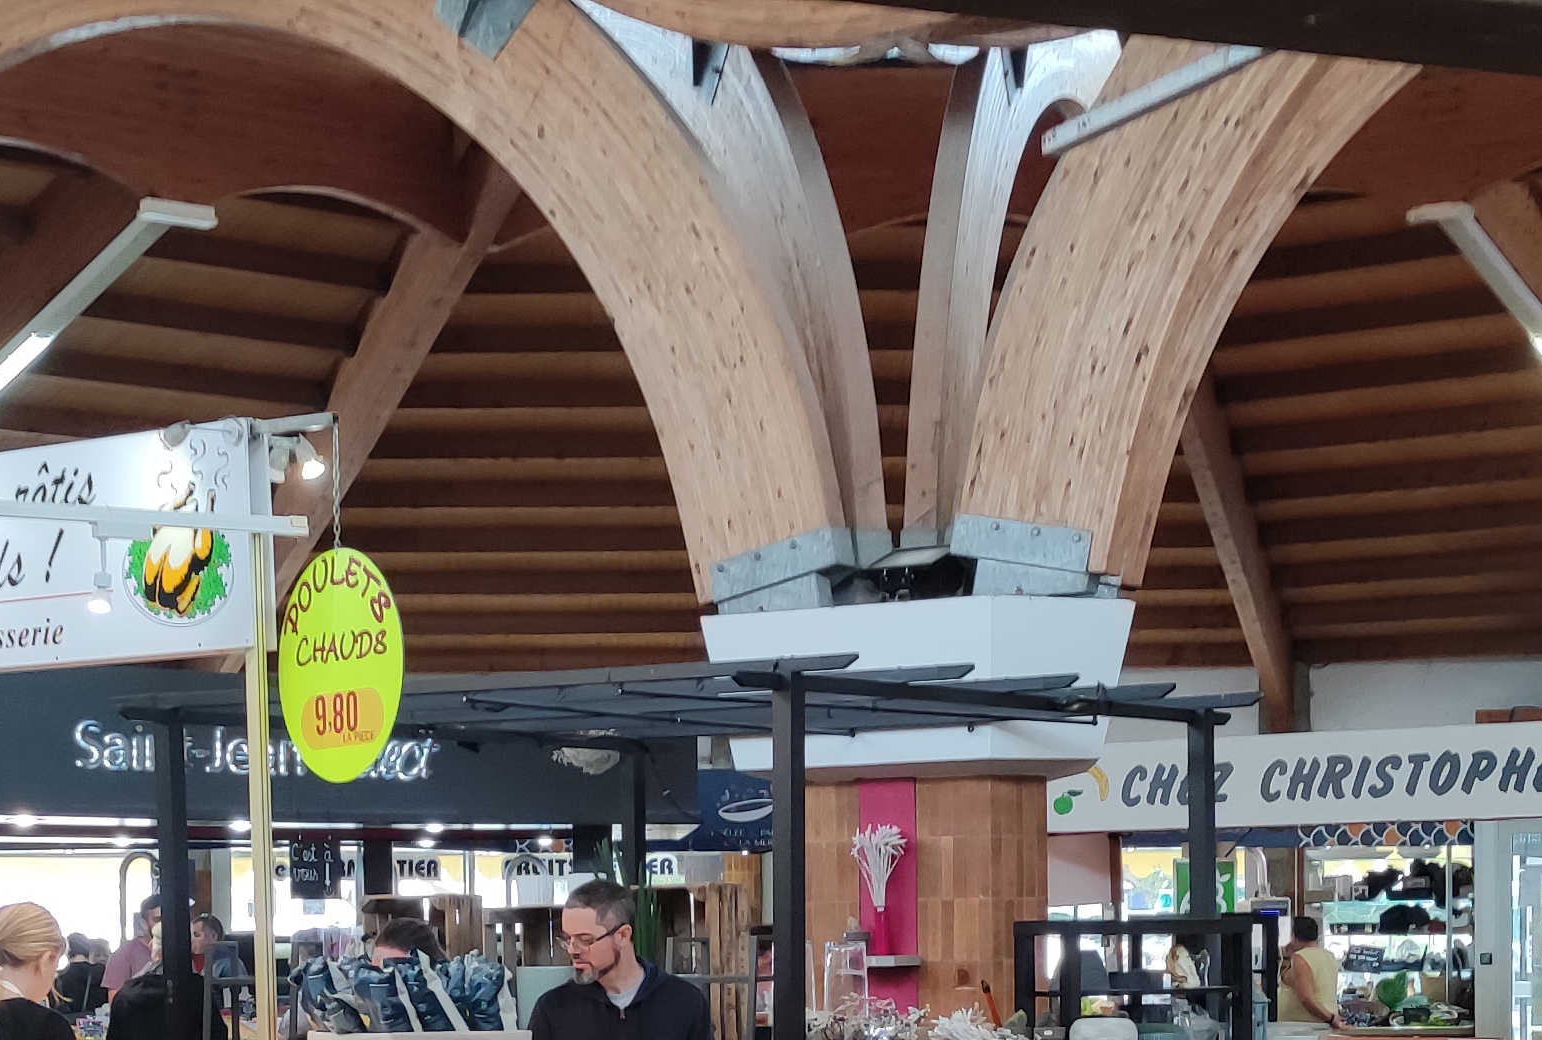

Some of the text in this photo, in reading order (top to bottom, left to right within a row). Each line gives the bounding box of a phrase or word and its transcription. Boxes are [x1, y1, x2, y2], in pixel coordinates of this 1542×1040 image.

[284, 554, 392, 635] POULETS
[296, 628, 388, 667] CHAUDS
[1122, 761, 1234, 807] CHZ
